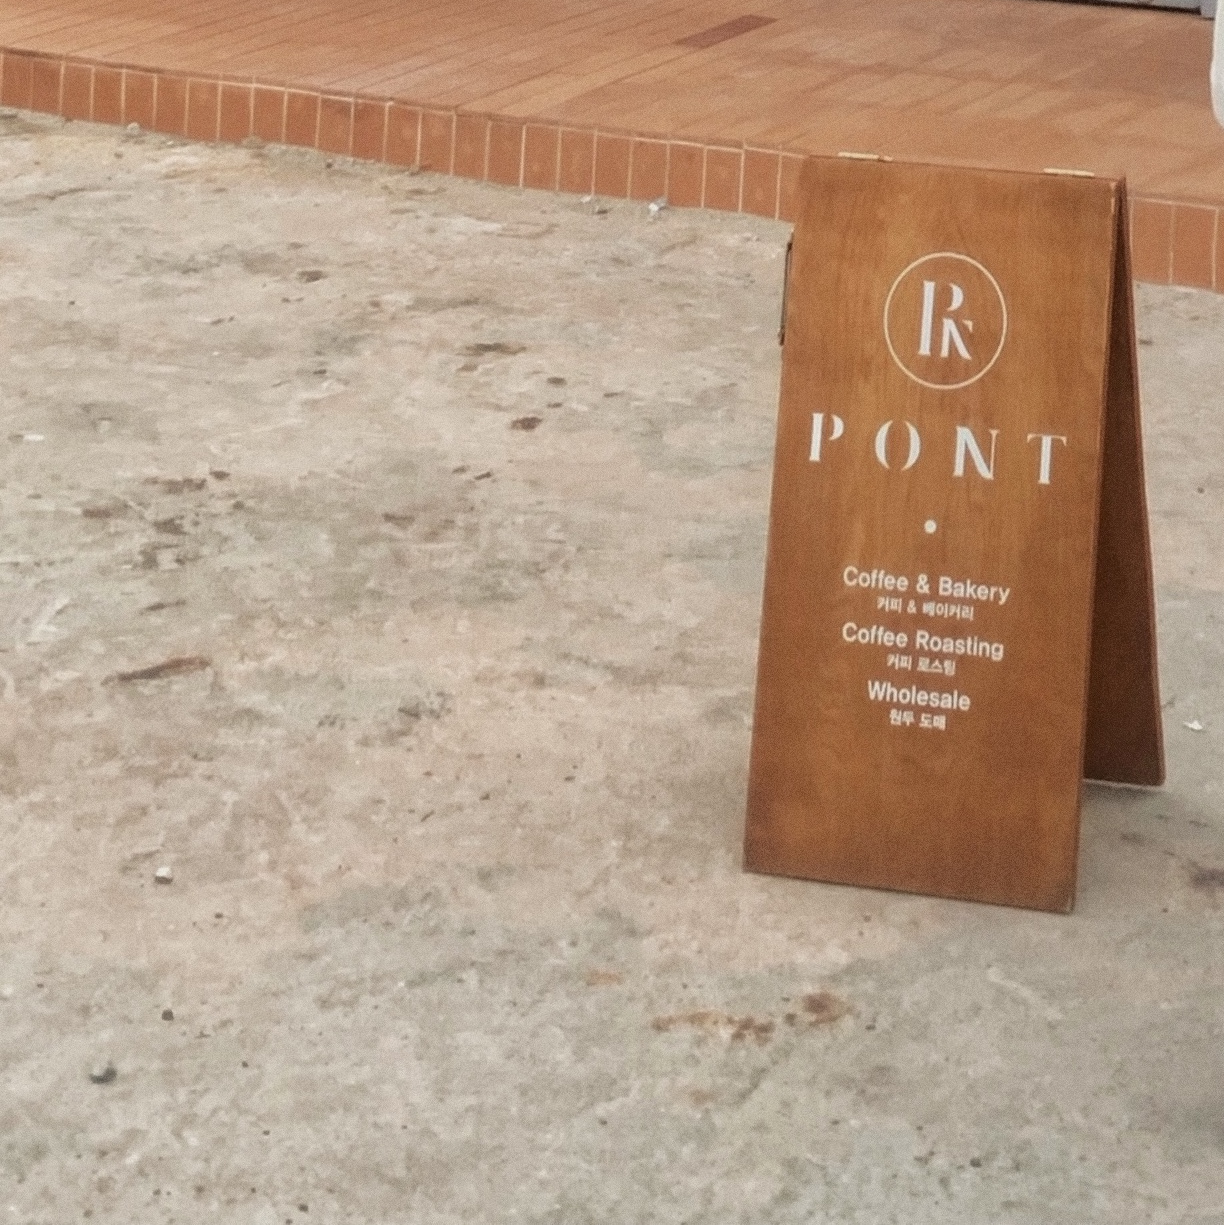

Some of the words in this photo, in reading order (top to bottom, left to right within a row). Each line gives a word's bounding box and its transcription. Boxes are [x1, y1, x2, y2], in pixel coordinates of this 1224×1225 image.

[808, 411, 1068, 486] PONT
[843, 565, 909, 592] Coffee
[916, 573, 930, 594] &
[938, 576, 1011, 606] Bakery
[876, 595, 903, 614] 커피
[906, 599, 917, 615] &
[842, 621, 909, 648] Coffee
[915, 629, 1005, 663] Roasting
[886, 653, 913, 672] 커피
[867, 679, 972, 712] Wholesale
